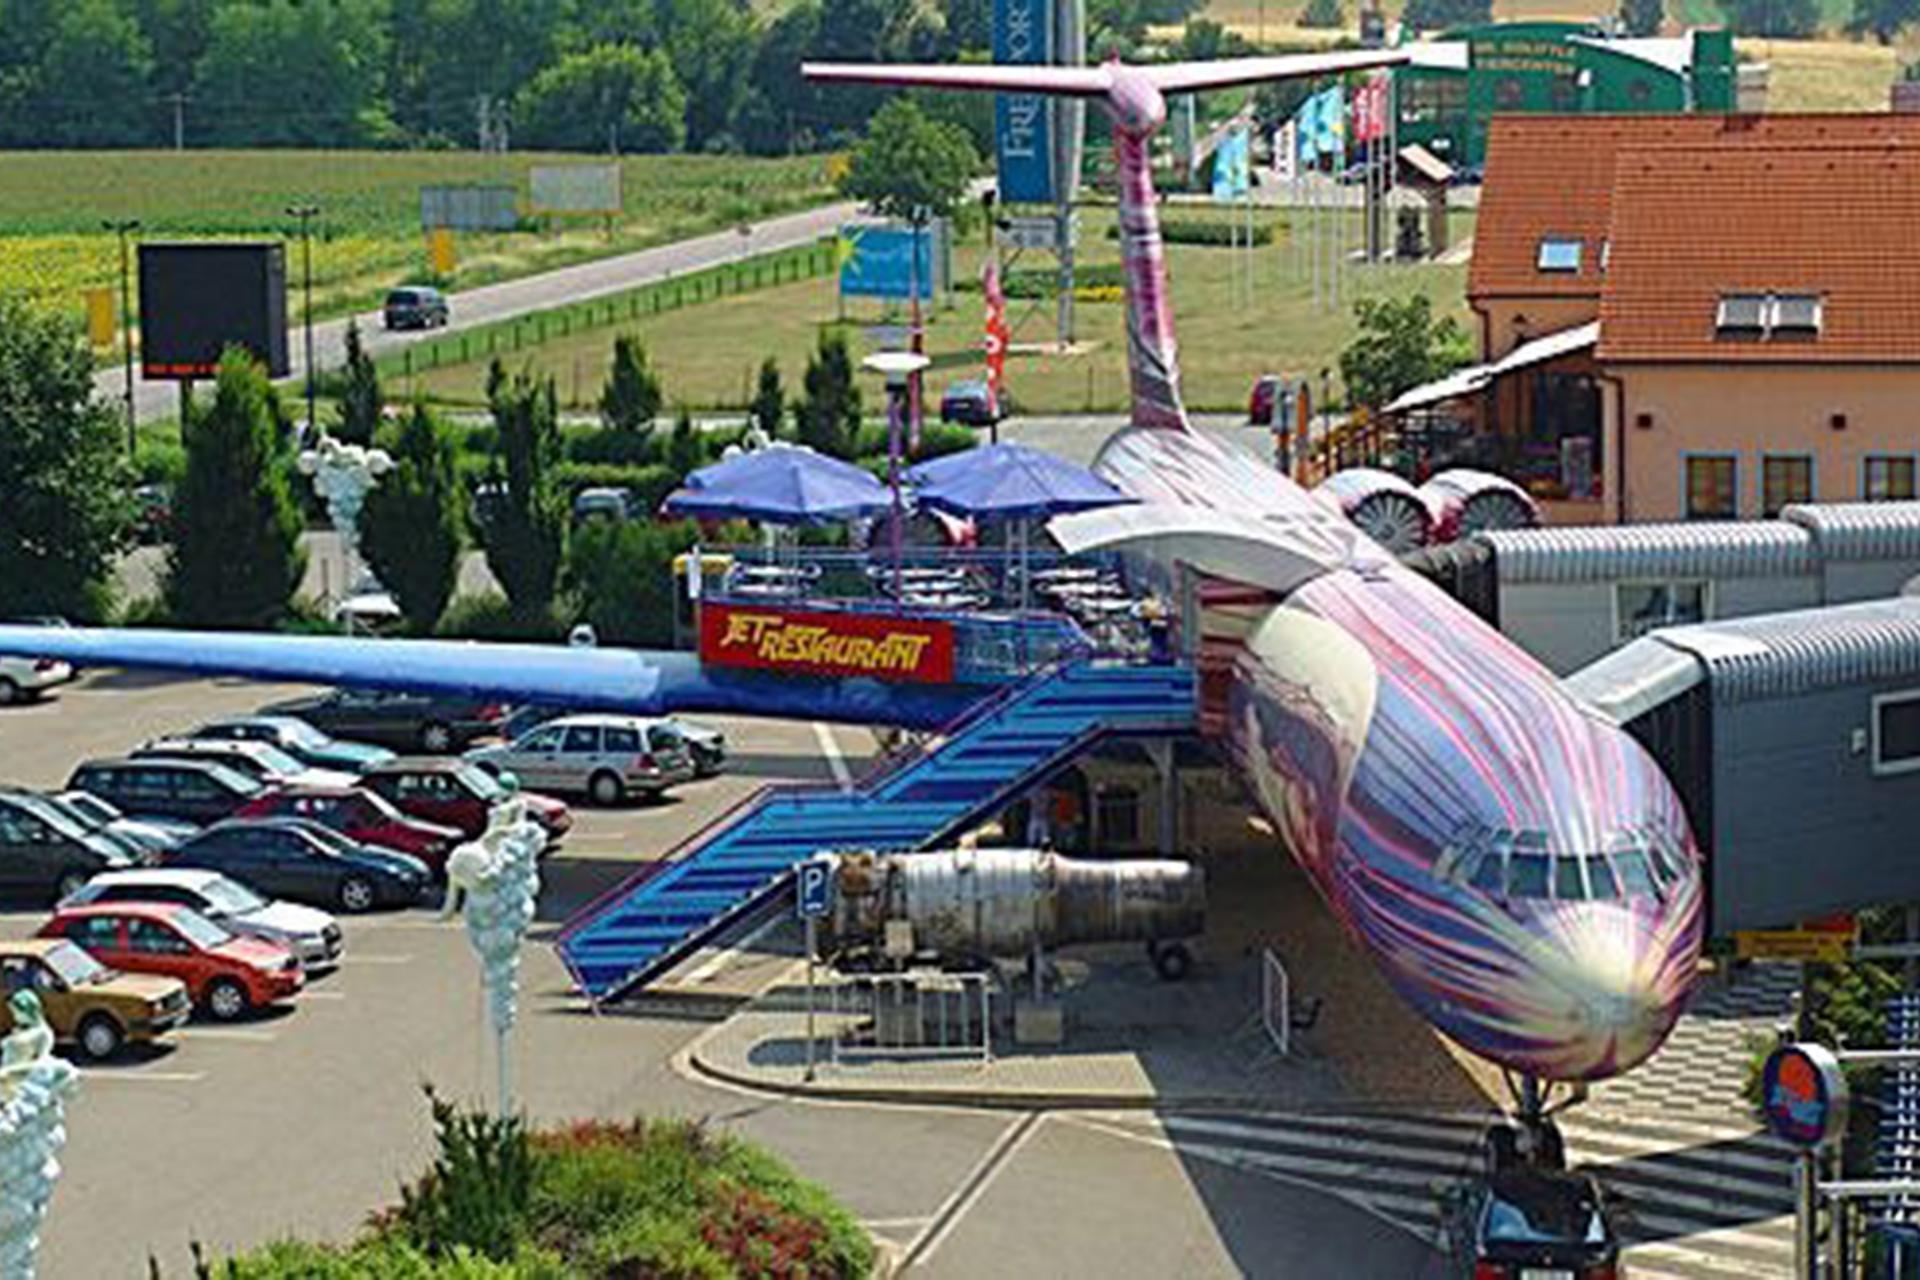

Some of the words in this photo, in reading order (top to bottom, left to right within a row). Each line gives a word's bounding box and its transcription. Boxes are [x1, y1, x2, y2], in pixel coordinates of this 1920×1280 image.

[720, 613, 784, 647] JET
[758, 624, 931, 670] RESTAURANT
[804, 867, 823, 899] P
